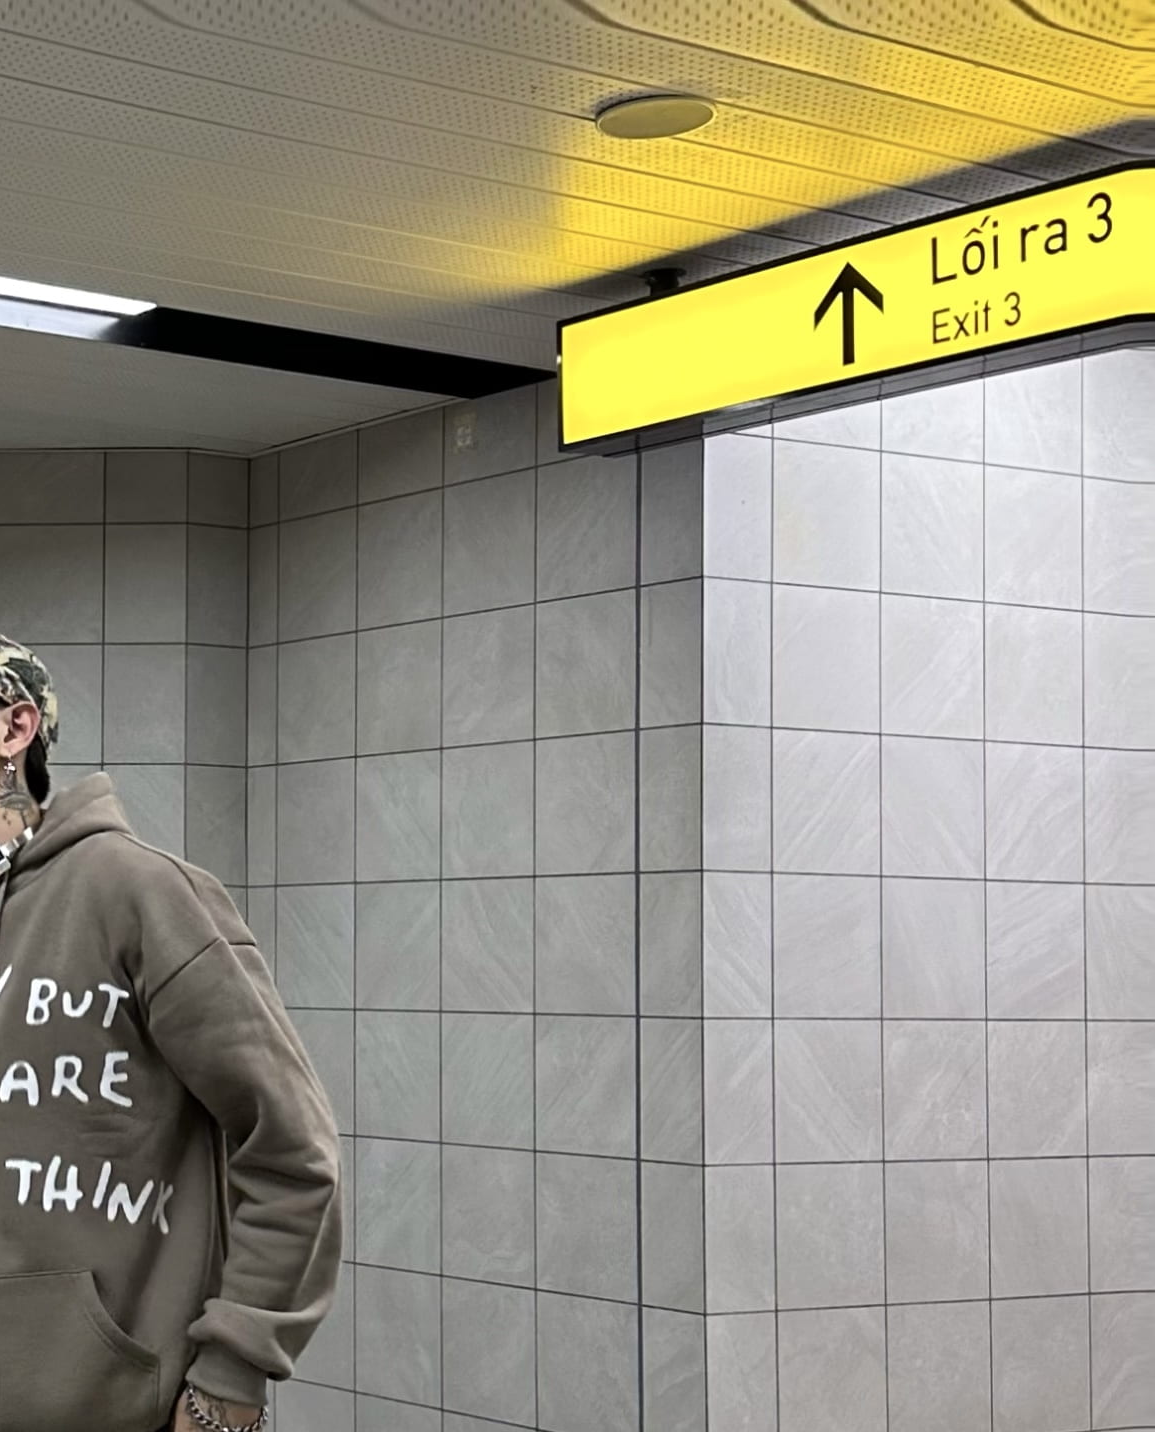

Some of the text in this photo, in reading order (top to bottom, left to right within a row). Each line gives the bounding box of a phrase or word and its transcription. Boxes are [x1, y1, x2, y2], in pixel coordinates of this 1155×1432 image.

[931, 192, 1113, 285] Lối ra 3
[932, 291, 1022, 345] Exit 3
[26, 977, 130, 1029] BUT
[0, 1051, 133, 1108] ARE
[5, 1155, 174, 1235] THINK
